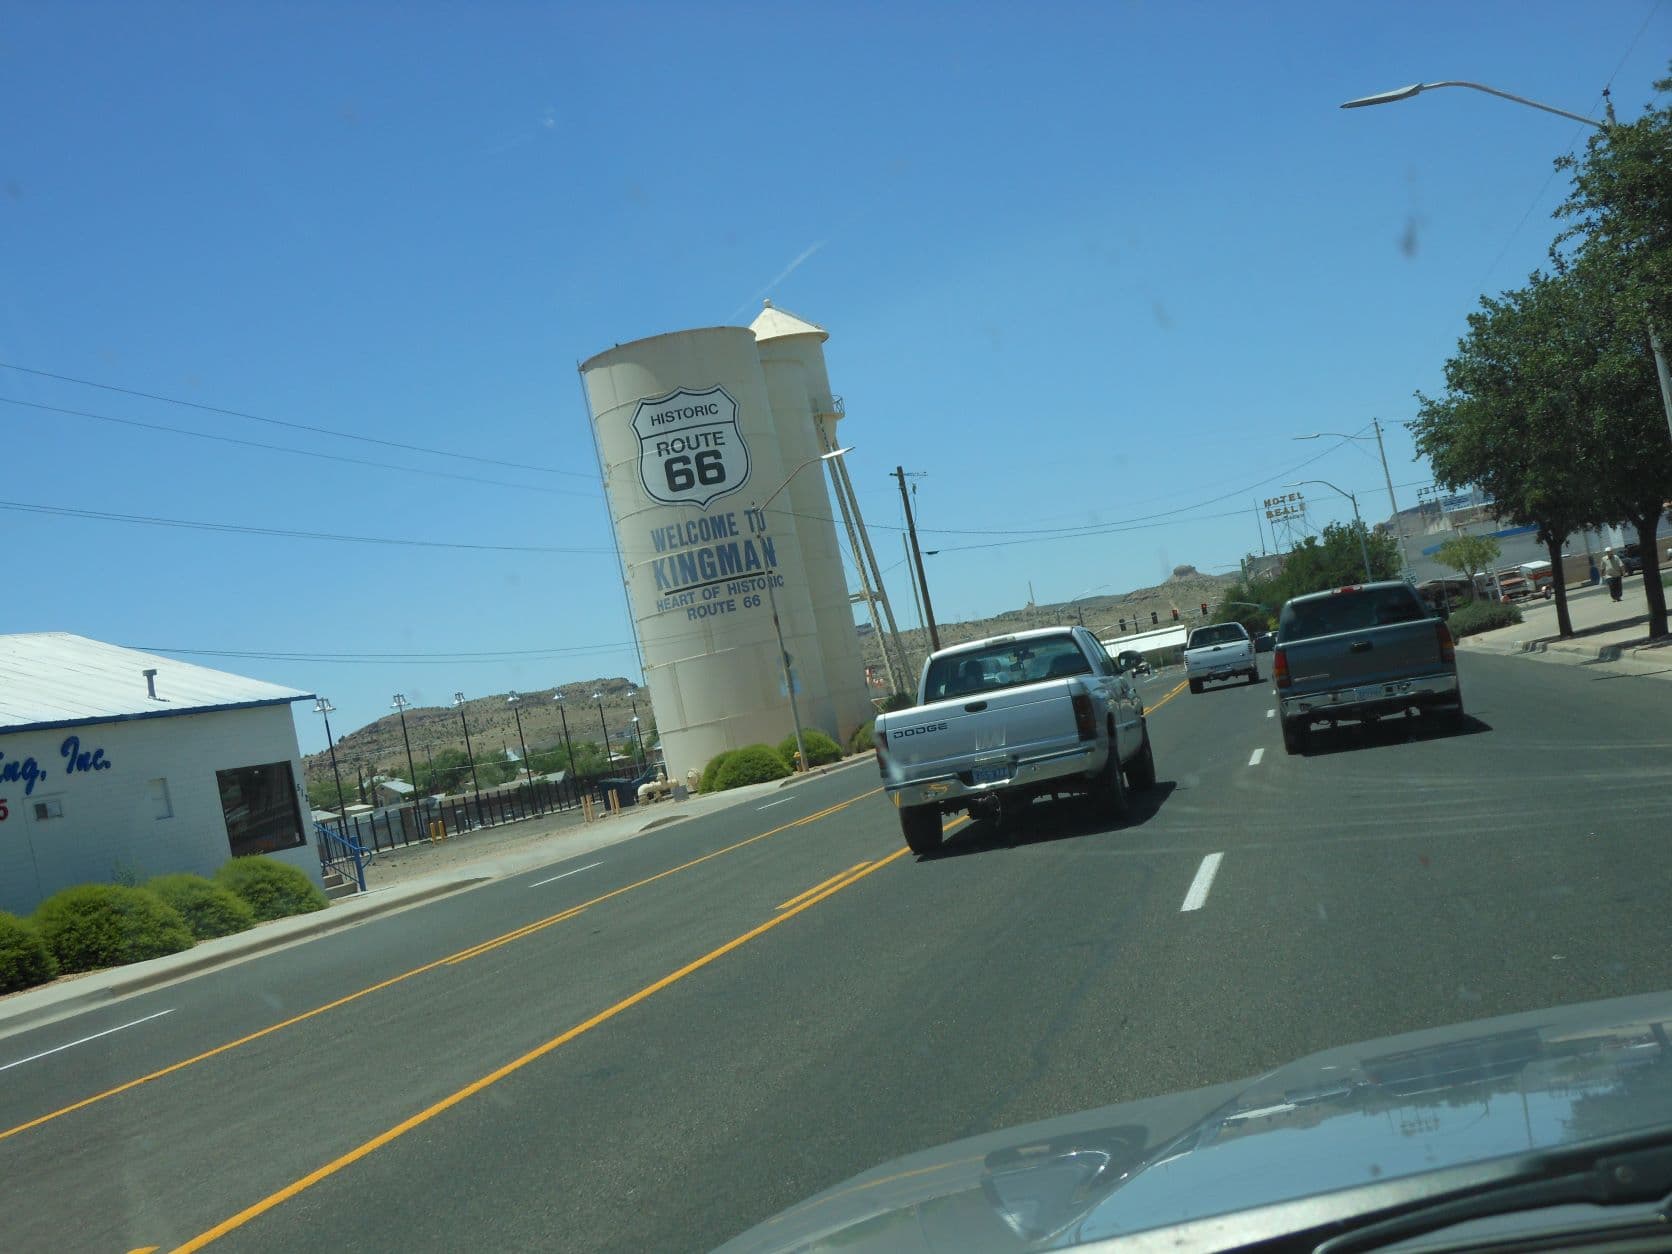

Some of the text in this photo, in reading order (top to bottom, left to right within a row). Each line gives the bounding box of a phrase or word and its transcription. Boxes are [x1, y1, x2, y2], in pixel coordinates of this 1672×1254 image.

[650, 403, 719, 426] HISTORIC
[656, 431, 726, 457] ROUTE
[664, 449, 726, 492] 66
[1263, 492, 1304, 508] MOTEL
[650, 509, 767, 554] WELCOME TO
[652, 537, 777, 592] KINGMAN
[656, 575, 784, 612] HEART OF HISTORIC
[687, 594, 761, 621] ROUTE 66
[893, 722, 948, 739] DODGE
[60, 735, 112, 775] Inc.
